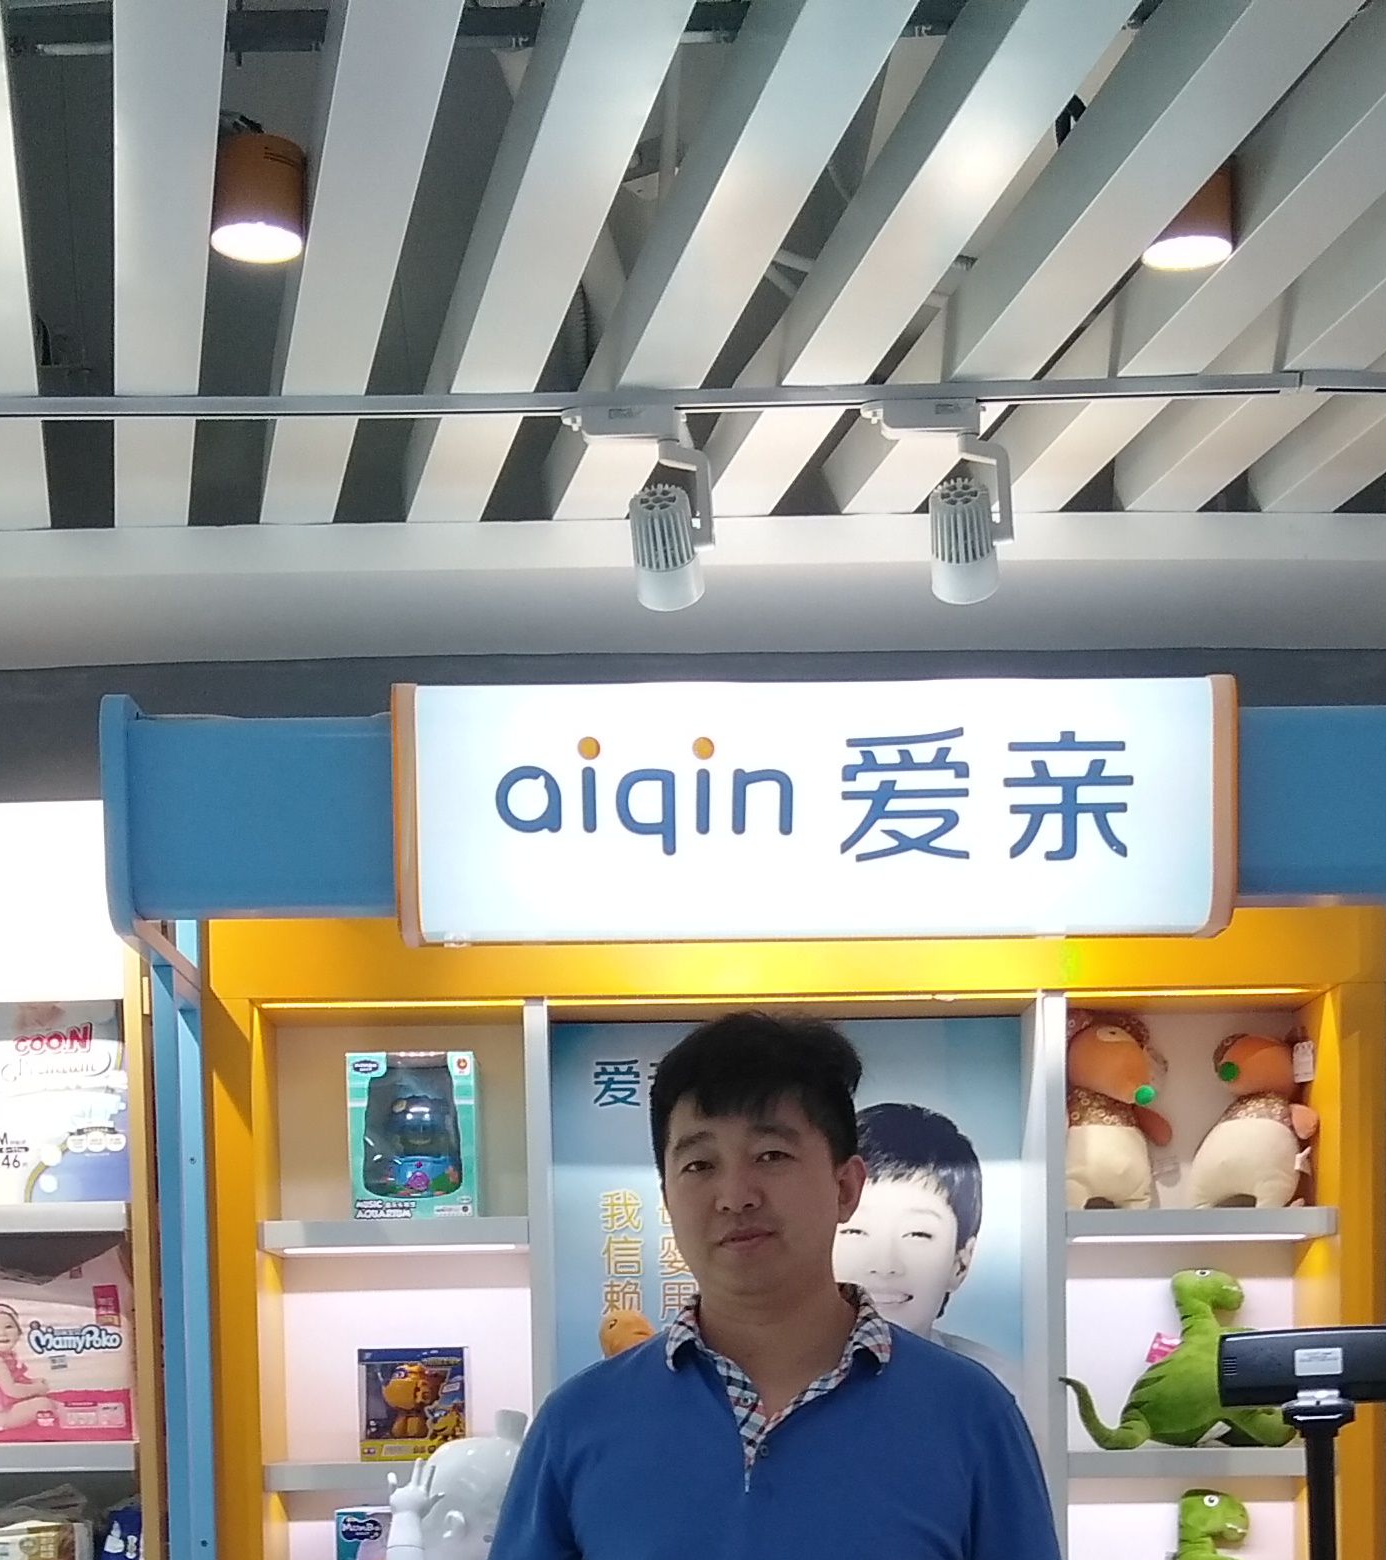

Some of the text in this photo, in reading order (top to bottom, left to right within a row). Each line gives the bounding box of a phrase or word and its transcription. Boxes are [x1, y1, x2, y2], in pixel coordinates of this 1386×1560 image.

[495, 727, 1133, 862] aiqin 爱亲
[593, 1060, 657, 1107] 爱
[600, 1190, 642, 1315] 我信赖
[28, 1320, 121, 1353] MamyPoko
